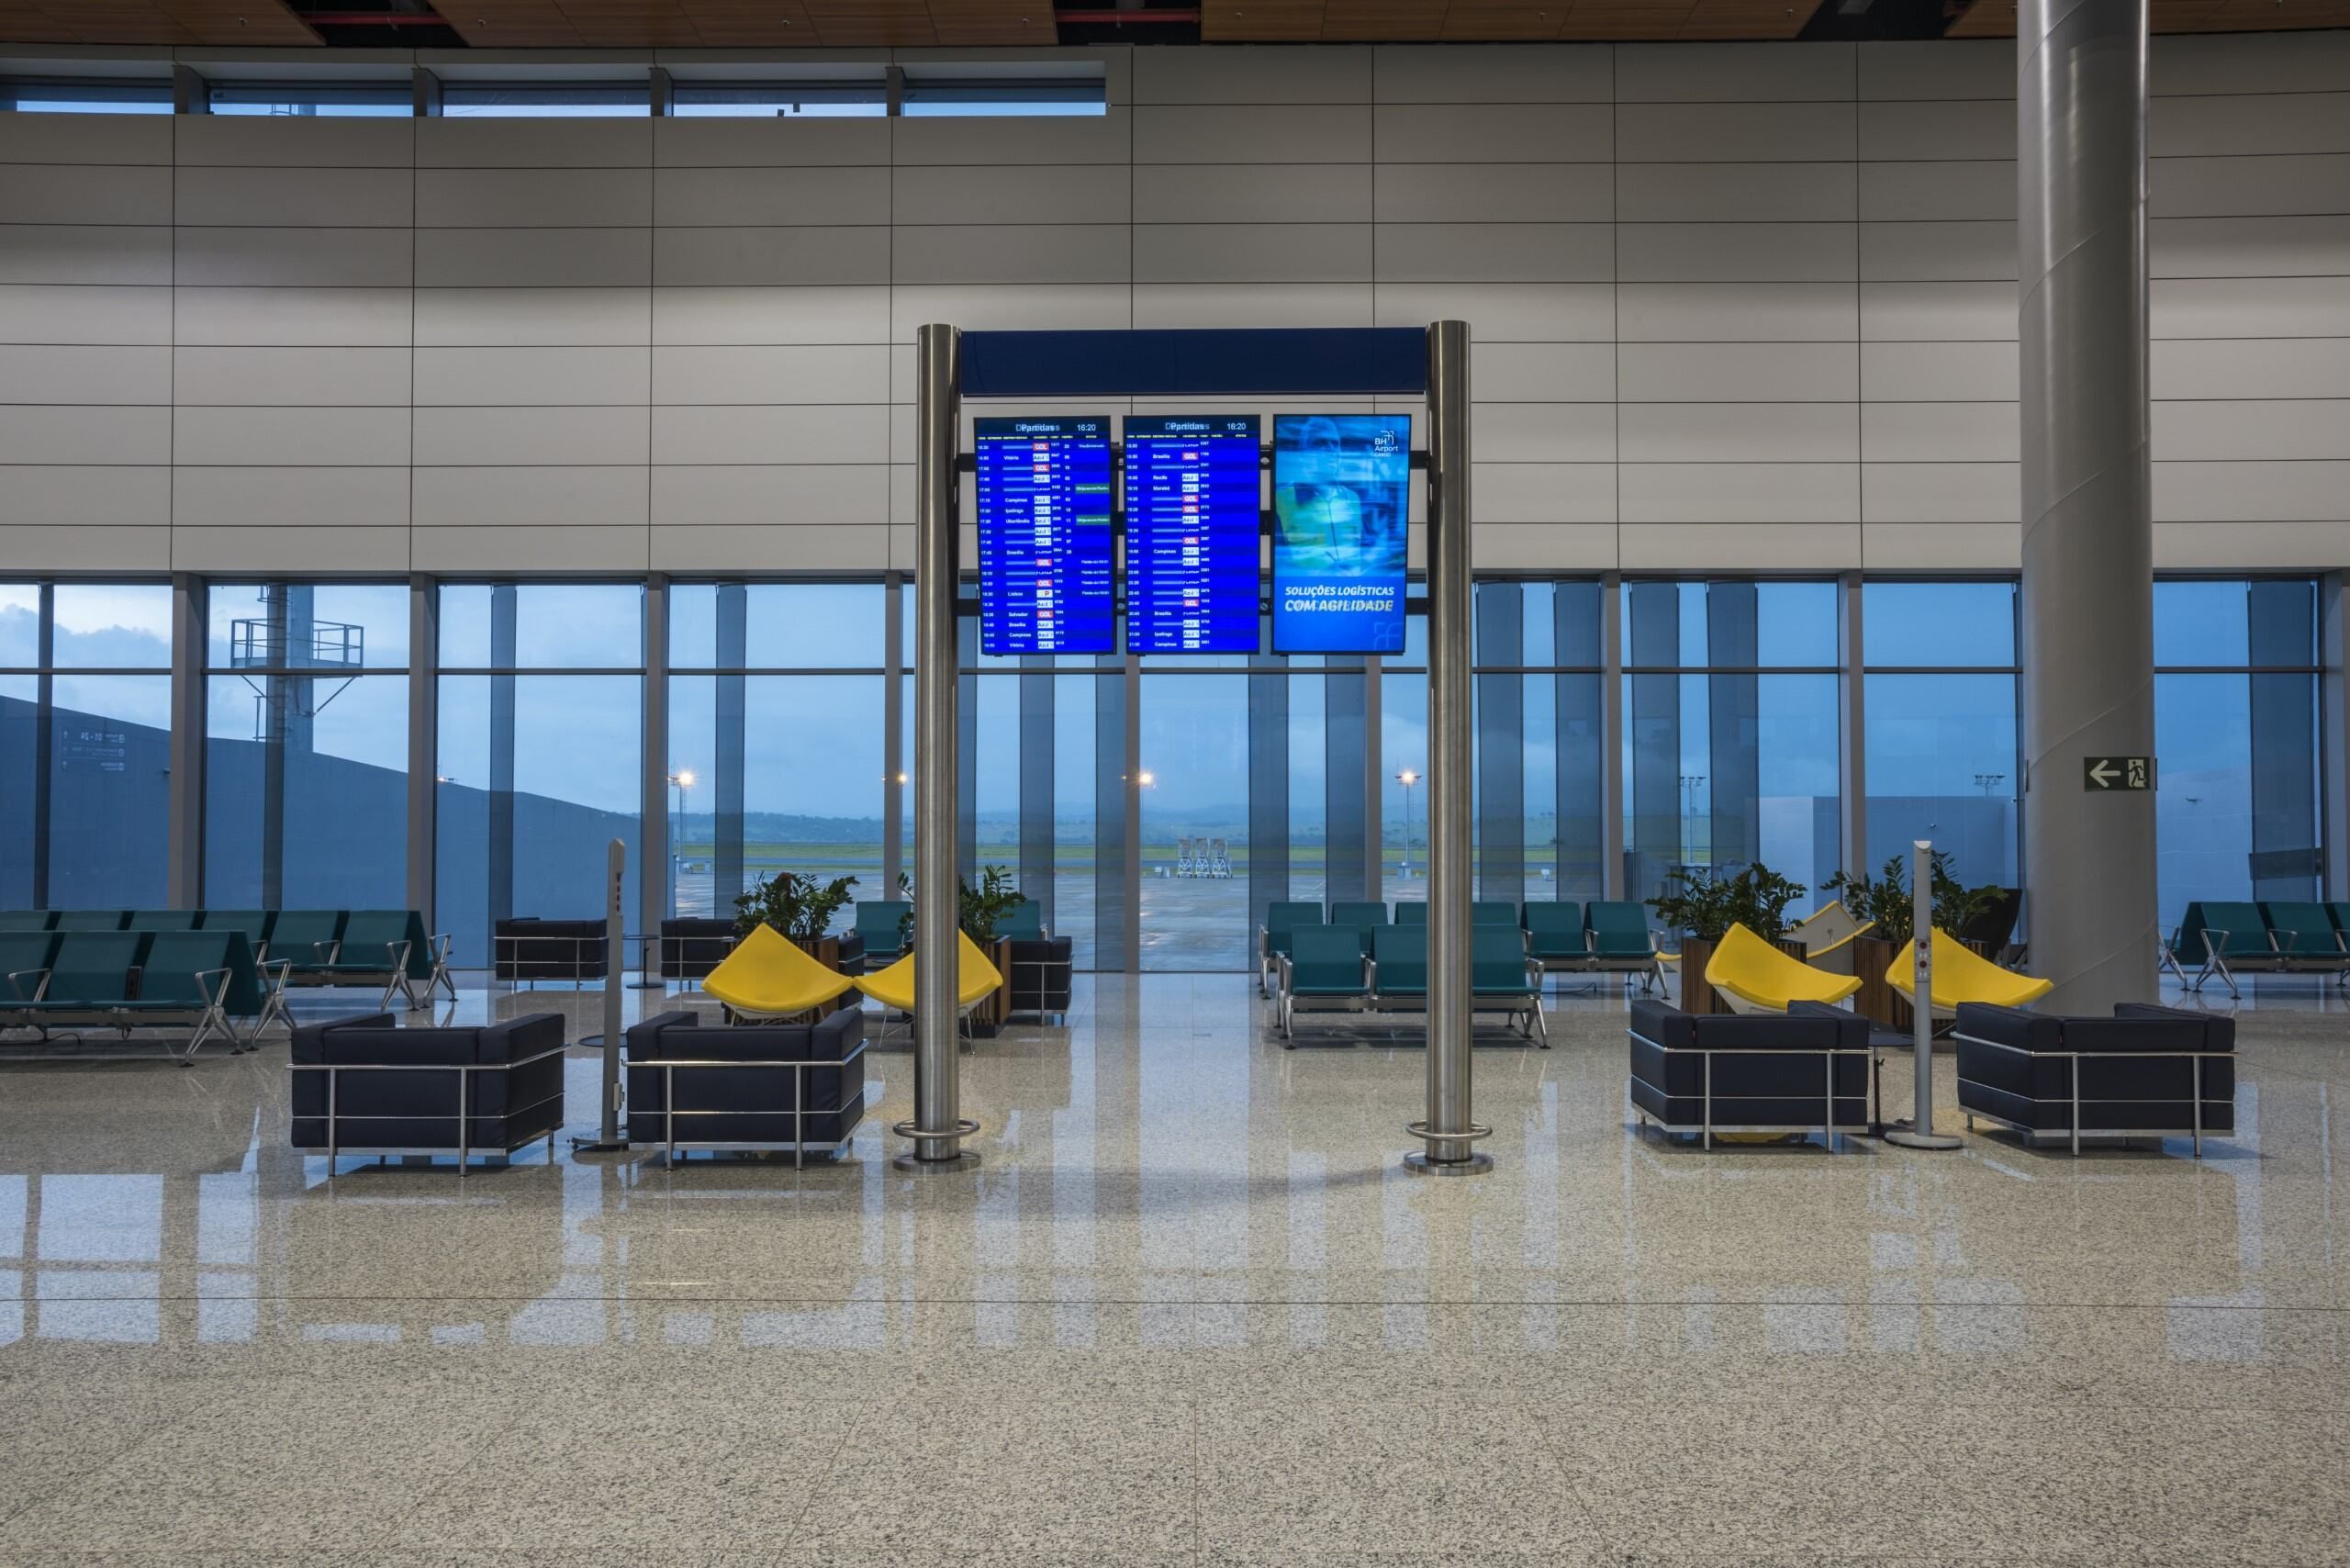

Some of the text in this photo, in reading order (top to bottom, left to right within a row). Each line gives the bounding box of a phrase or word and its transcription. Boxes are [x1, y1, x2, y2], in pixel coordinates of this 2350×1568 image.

[1226, 422, 1247, 431] 16:20
[1374, 437, 1387, 445] BH
[1285, 585, 1394, 598] SOLUÇÕES LOGÍSTICAS
[1285, 599, 1315, 611] COM
